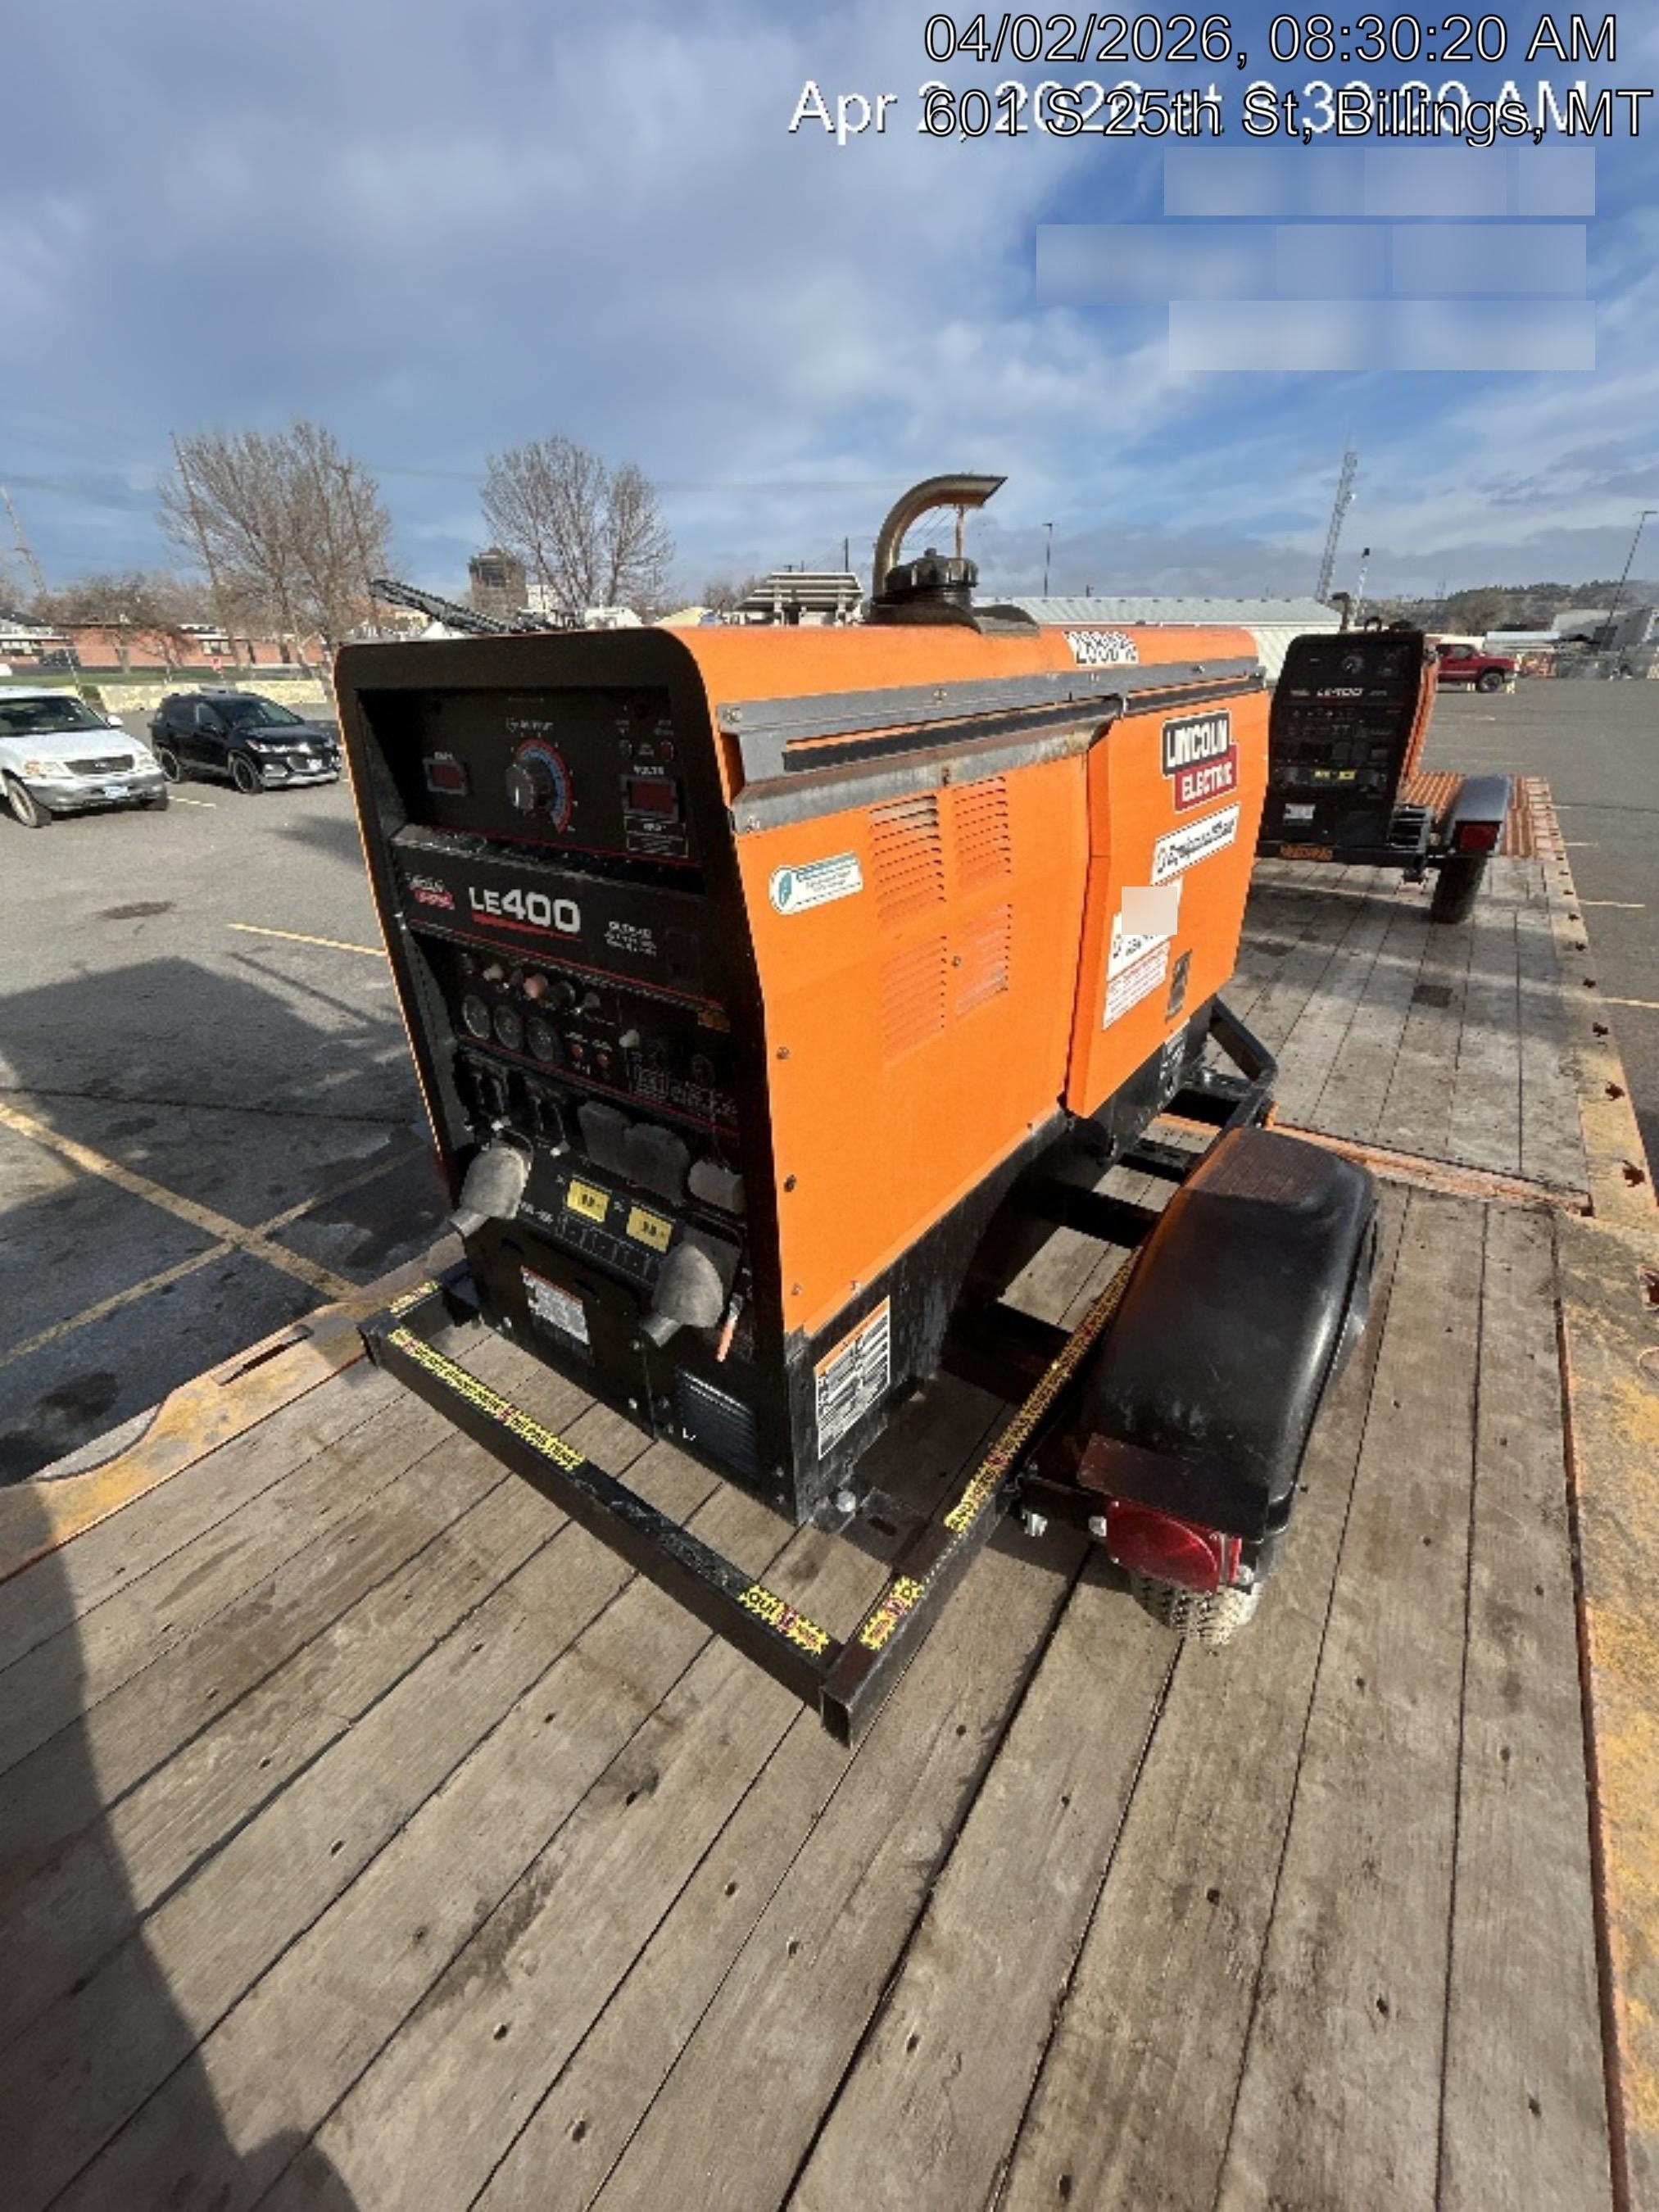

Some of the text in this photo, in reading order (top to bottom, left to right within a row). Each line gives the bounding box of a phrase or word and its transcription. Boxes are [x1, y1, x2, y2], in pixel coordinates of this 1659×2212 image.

[1167, 718, 1228, 768] LINCOLN
[1181, 760, 1233, 803] ELECTRIC
[468, 886, 582, 933] LE400
